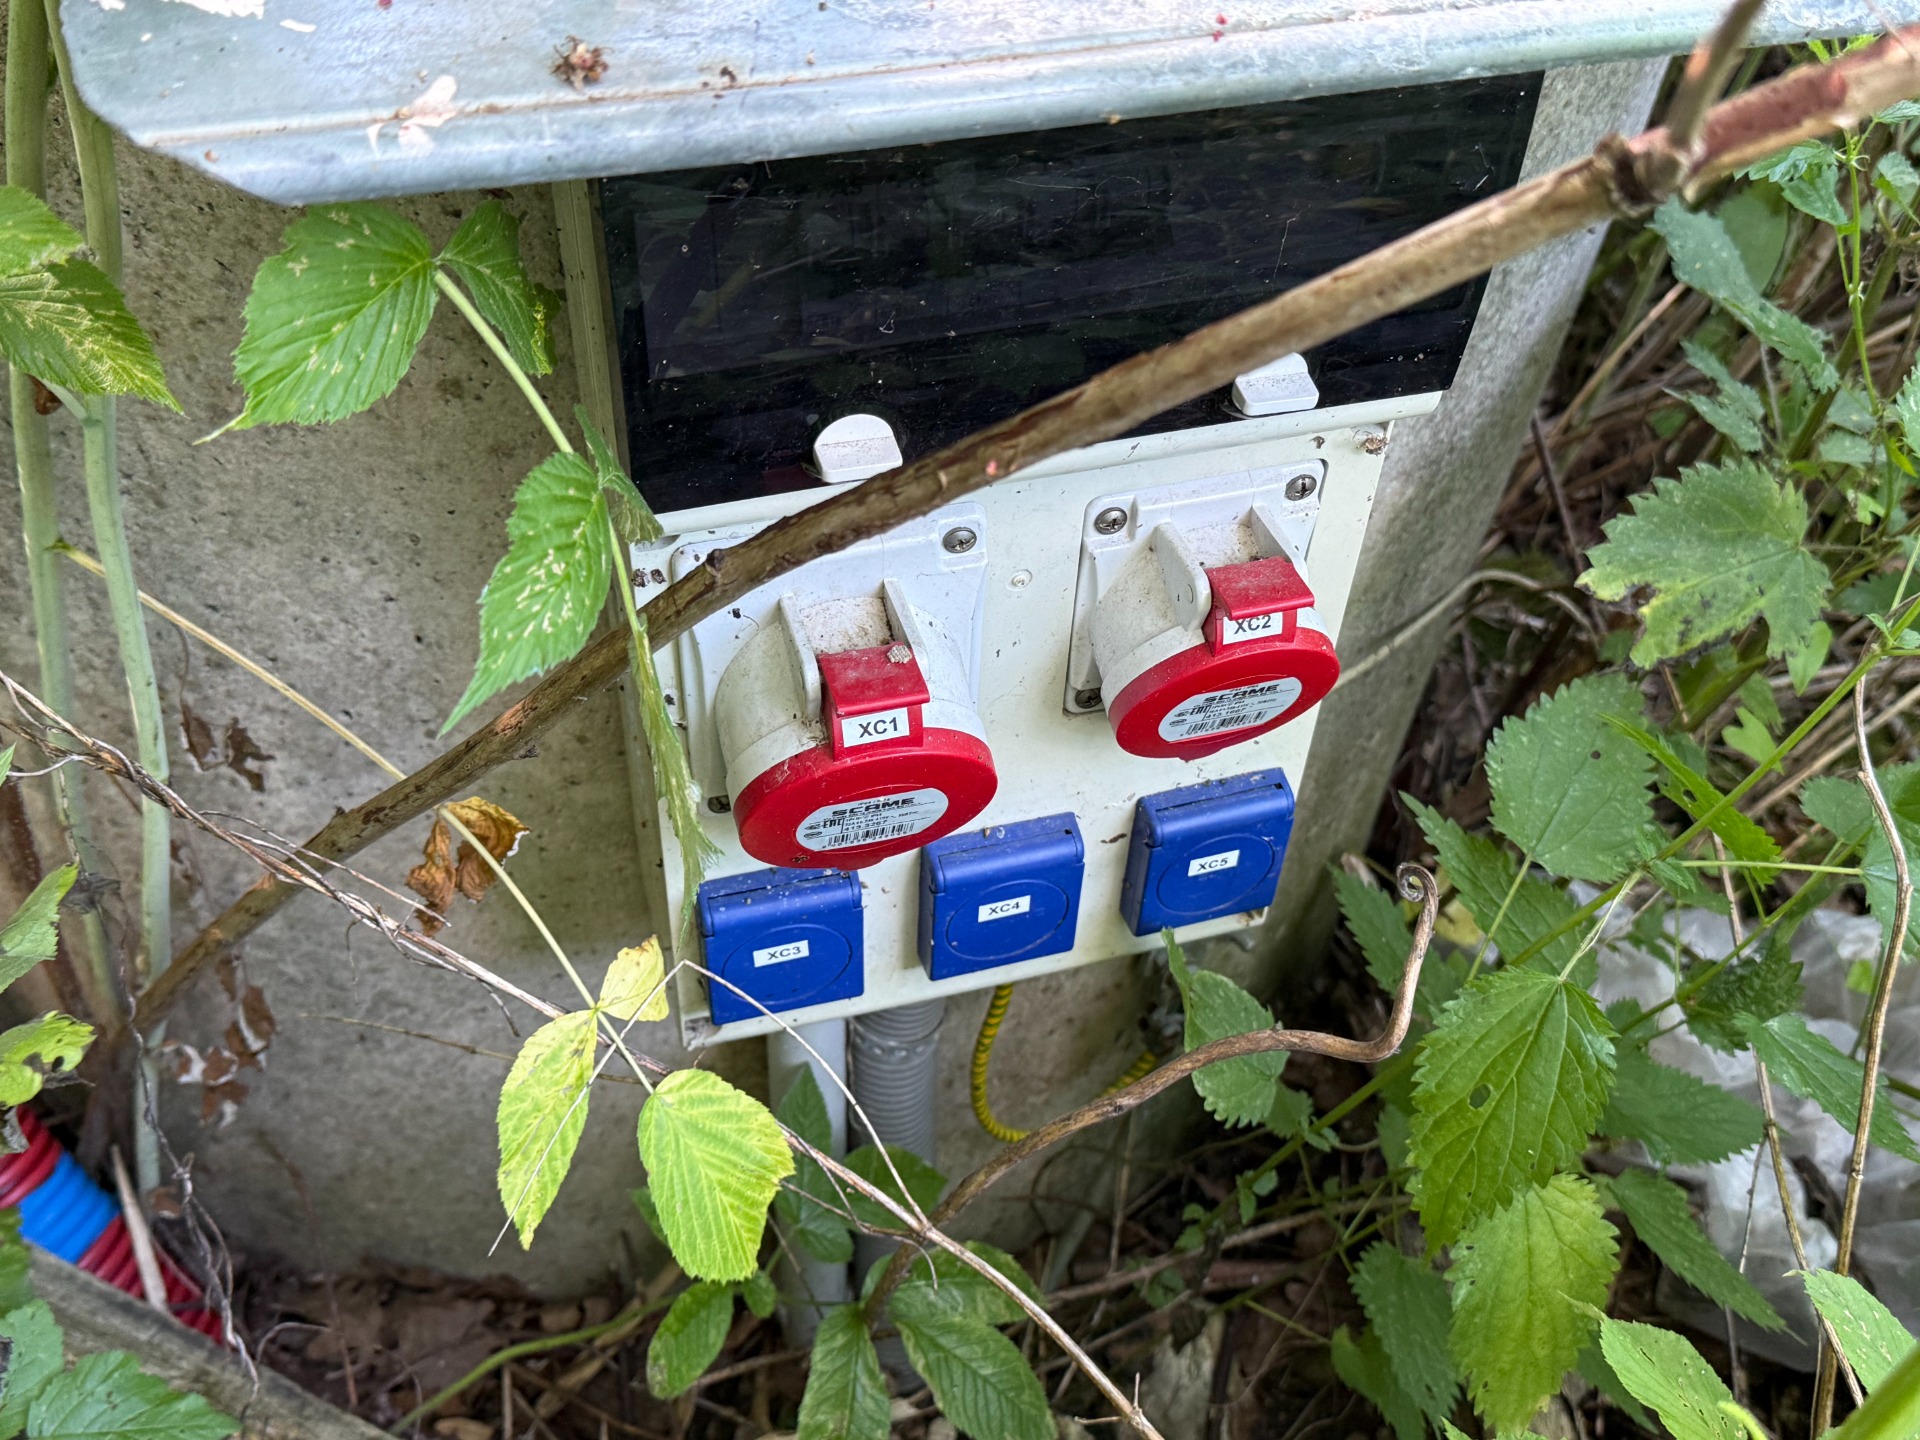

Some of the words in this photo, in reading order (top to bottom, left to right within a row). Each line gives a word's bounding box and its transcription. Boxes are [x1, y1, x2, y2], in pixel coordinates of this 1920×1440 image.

[1234, 614, 1272, 635] XC2
[1203, 684, 1280, 703] SCAME
[858, 716, 898, 739] XC1
[832, 797, 915, 817] SCAME
[1197, 857, 1229, 872] XC5
[988, 901, 1020, 917] XC4
[767, 946, 802, 961] XC3
